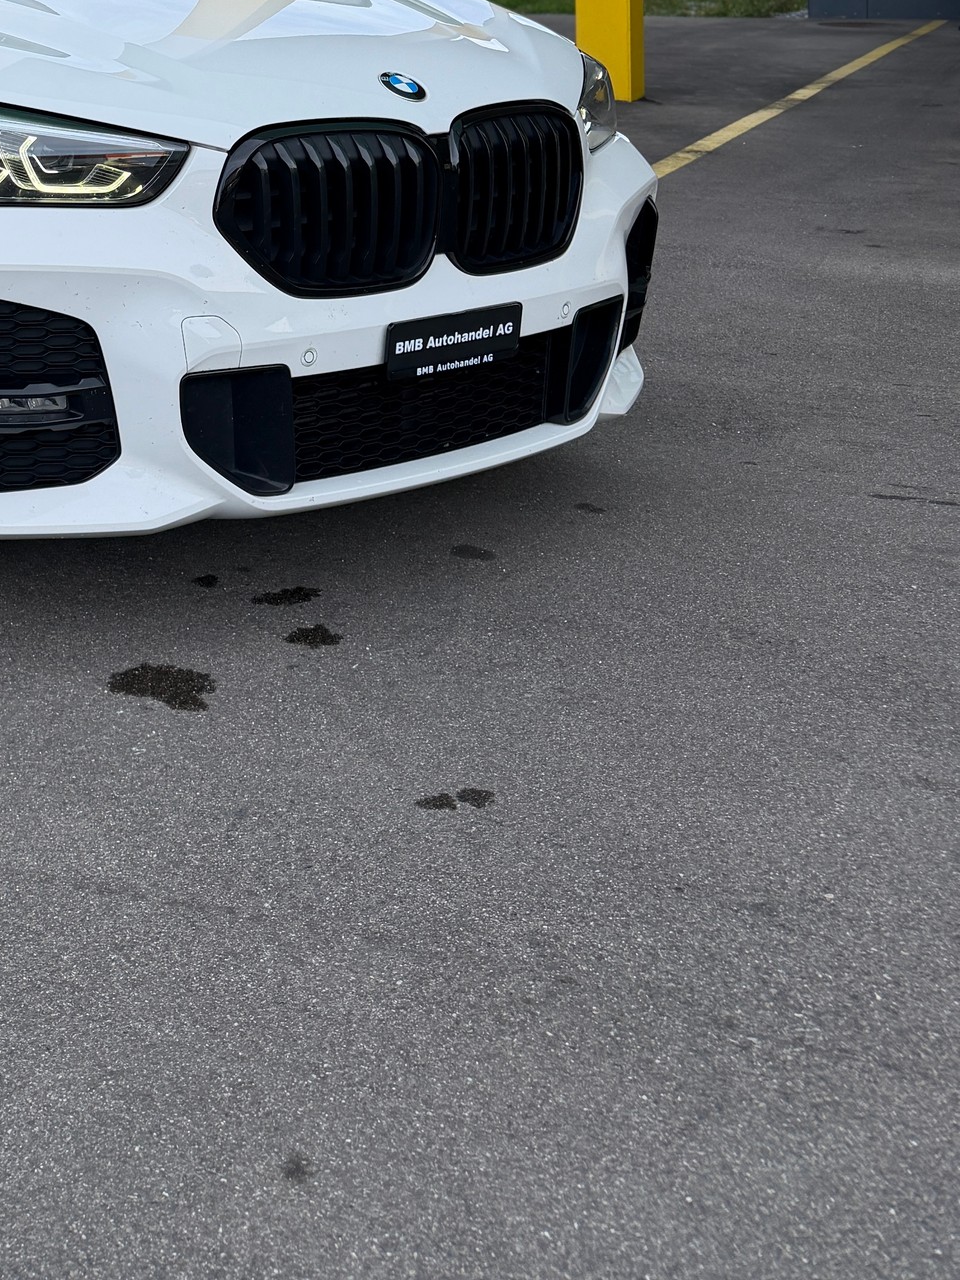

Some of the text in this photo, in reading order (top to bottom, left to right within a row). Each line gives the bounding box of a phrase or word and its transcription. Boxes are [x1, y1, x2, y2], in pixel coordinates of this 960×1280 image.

[395, 321, 514, 355] BMB Autohandel AG
[416, 353, 494, 376] BMB Autohandel AG
